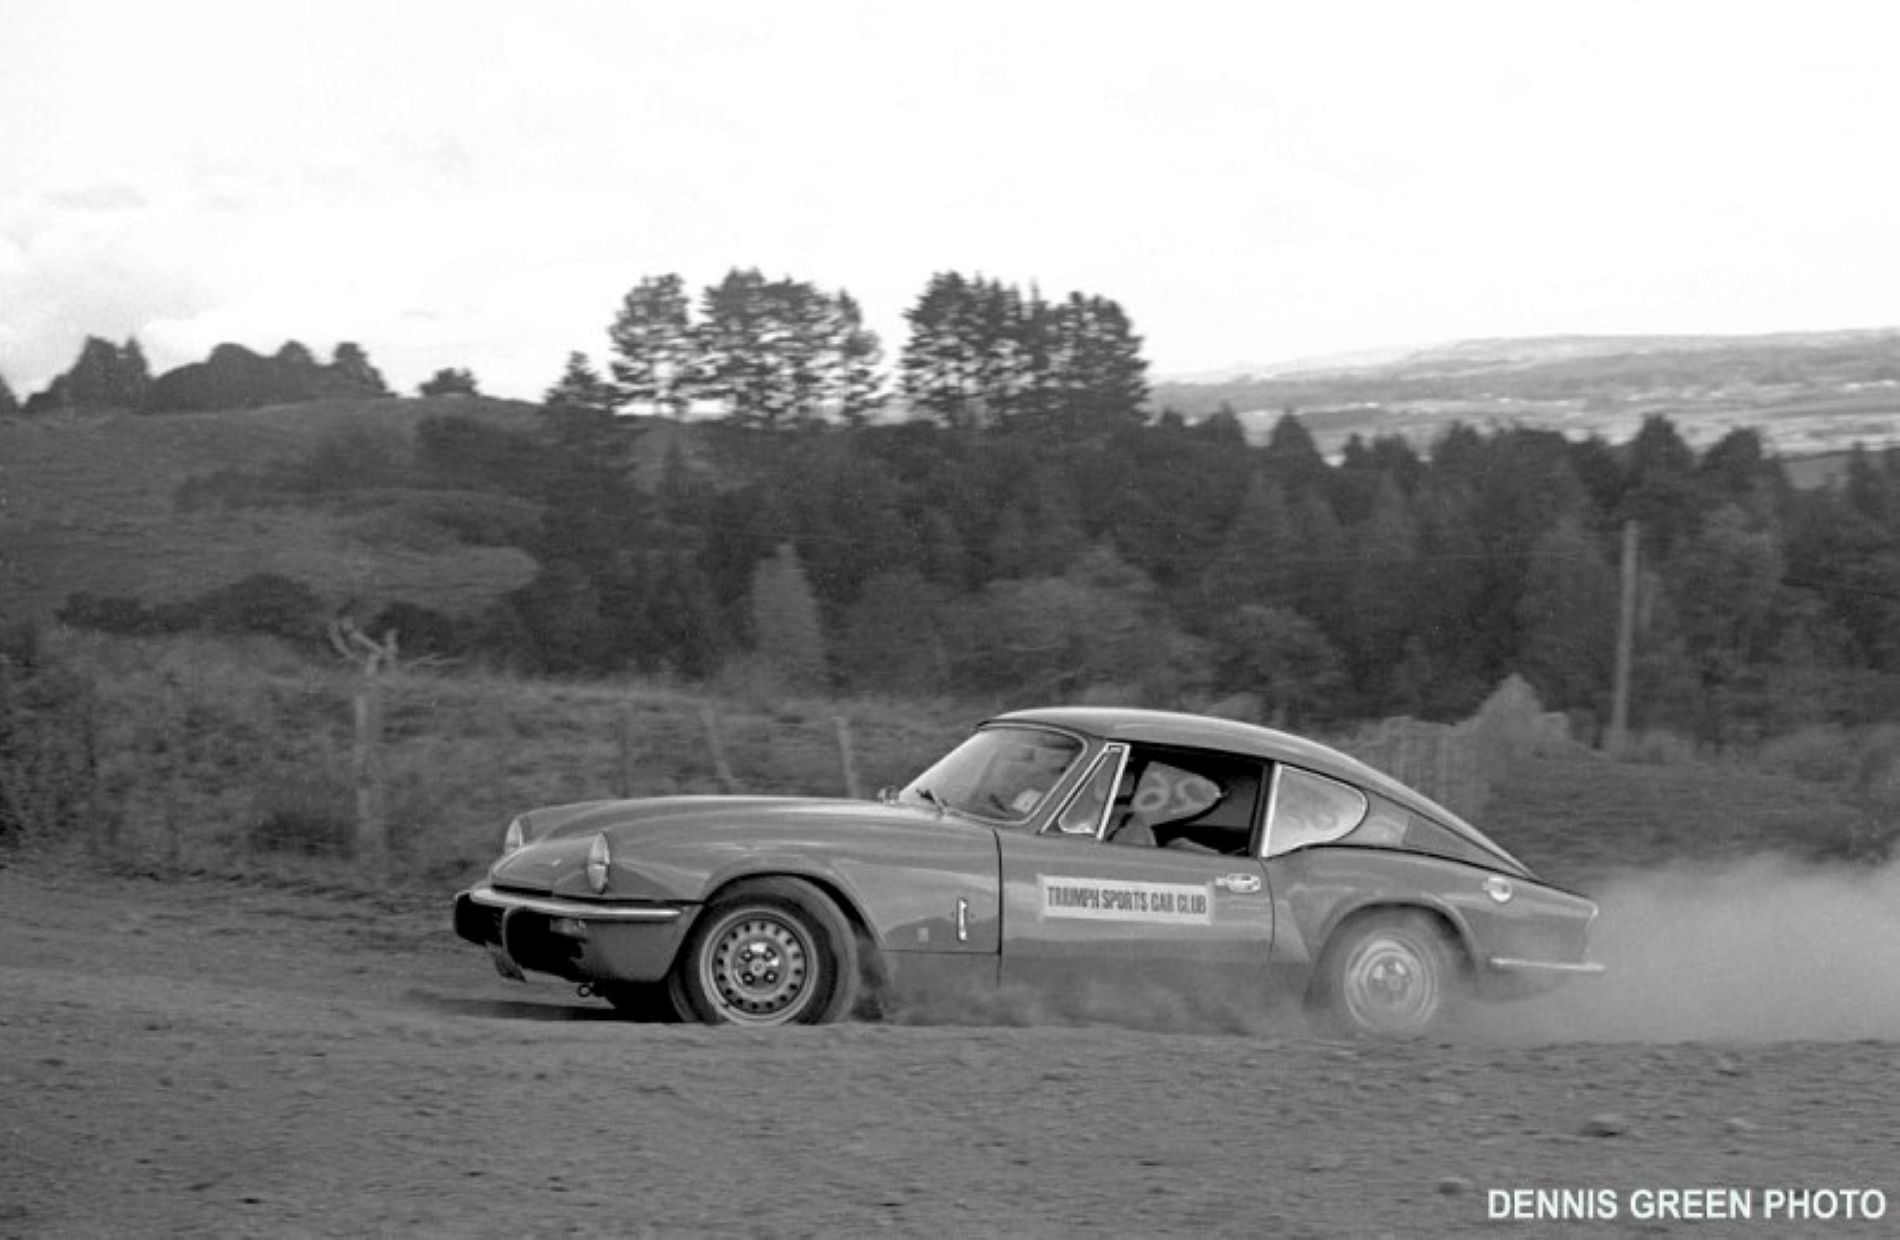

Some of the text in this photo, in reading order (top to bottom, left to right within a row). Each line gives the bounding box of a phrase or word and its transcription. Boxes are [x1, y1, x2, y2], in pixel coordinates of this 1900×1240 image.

[1047, 886, 1207, 914] TRIUMPH SPORTS CAR CLUB
